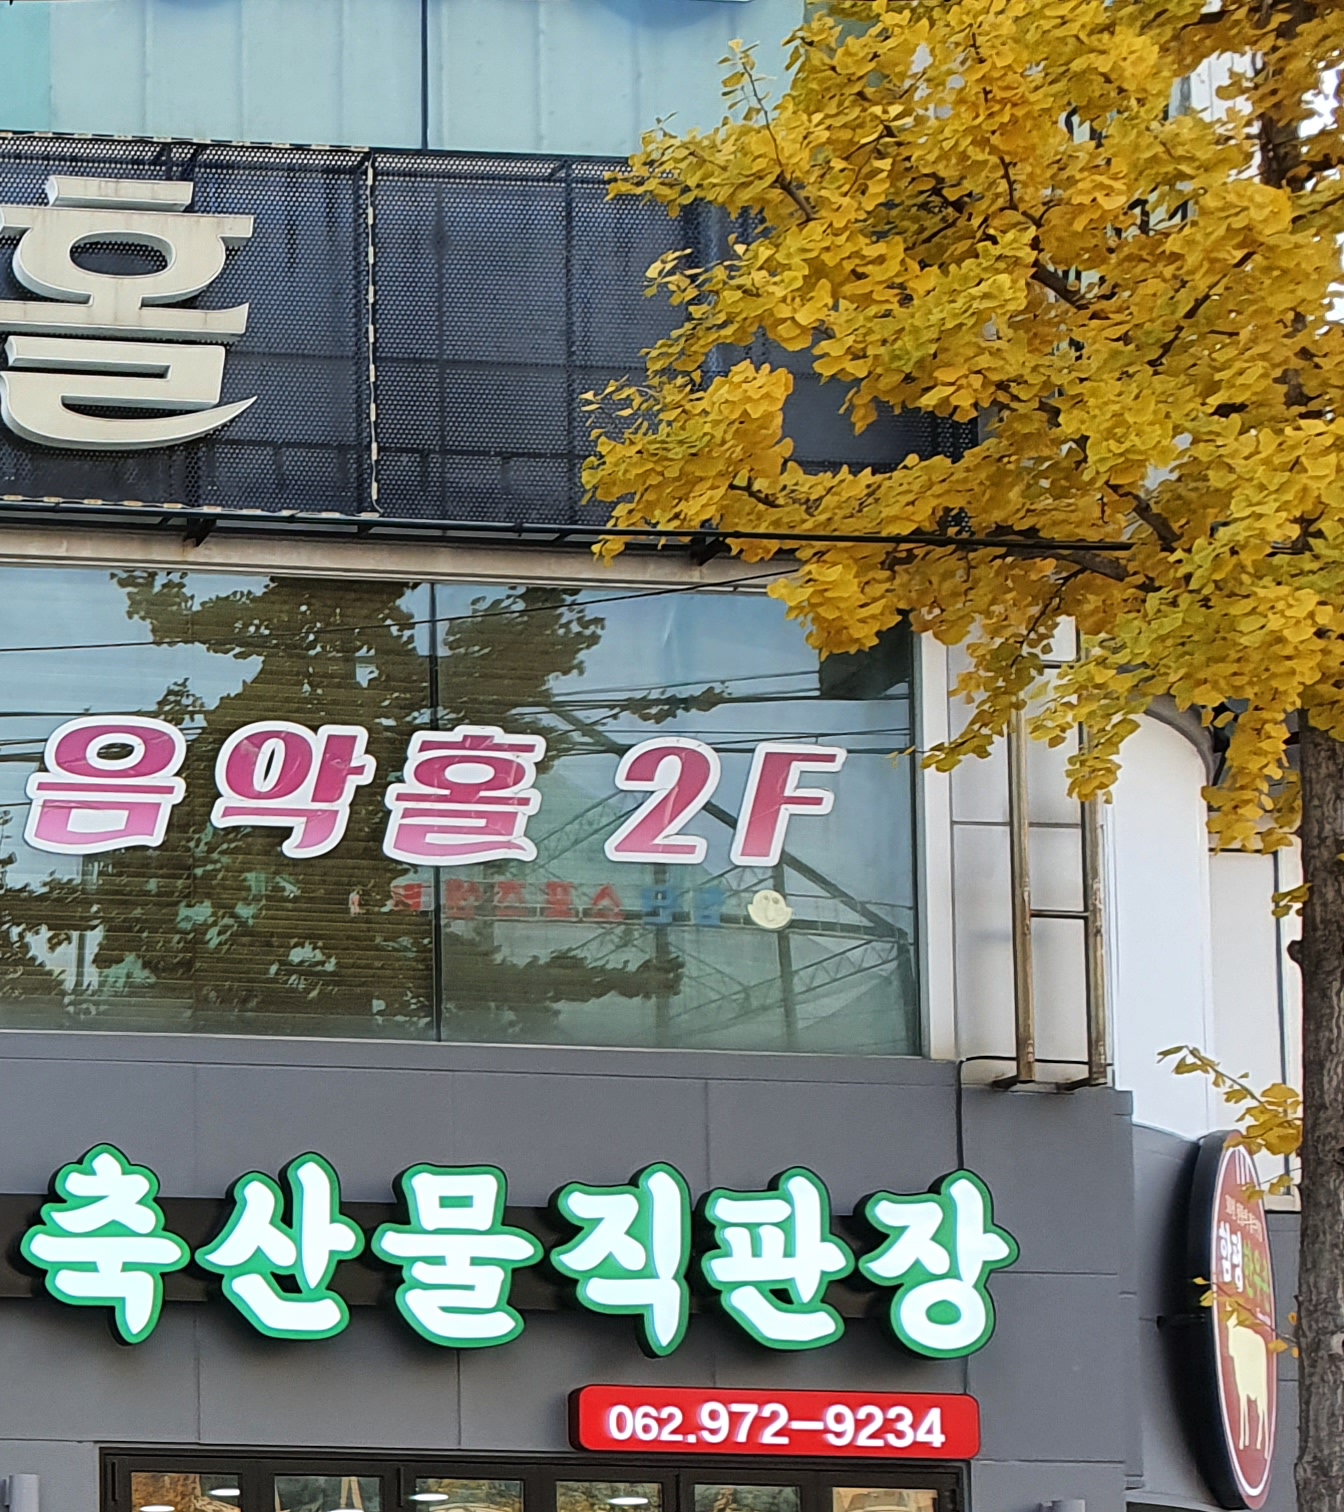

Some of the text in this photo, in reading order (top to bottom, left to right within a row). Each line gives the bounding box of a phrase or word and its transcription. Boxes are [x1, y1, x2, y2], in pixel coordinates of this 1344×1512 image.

[25, 715, 848, 867] 음악홀 2F
[20, 1141, 1021, 1361] 축산물직판장
[608, 1401, 947, 1449] 062.972-9234
